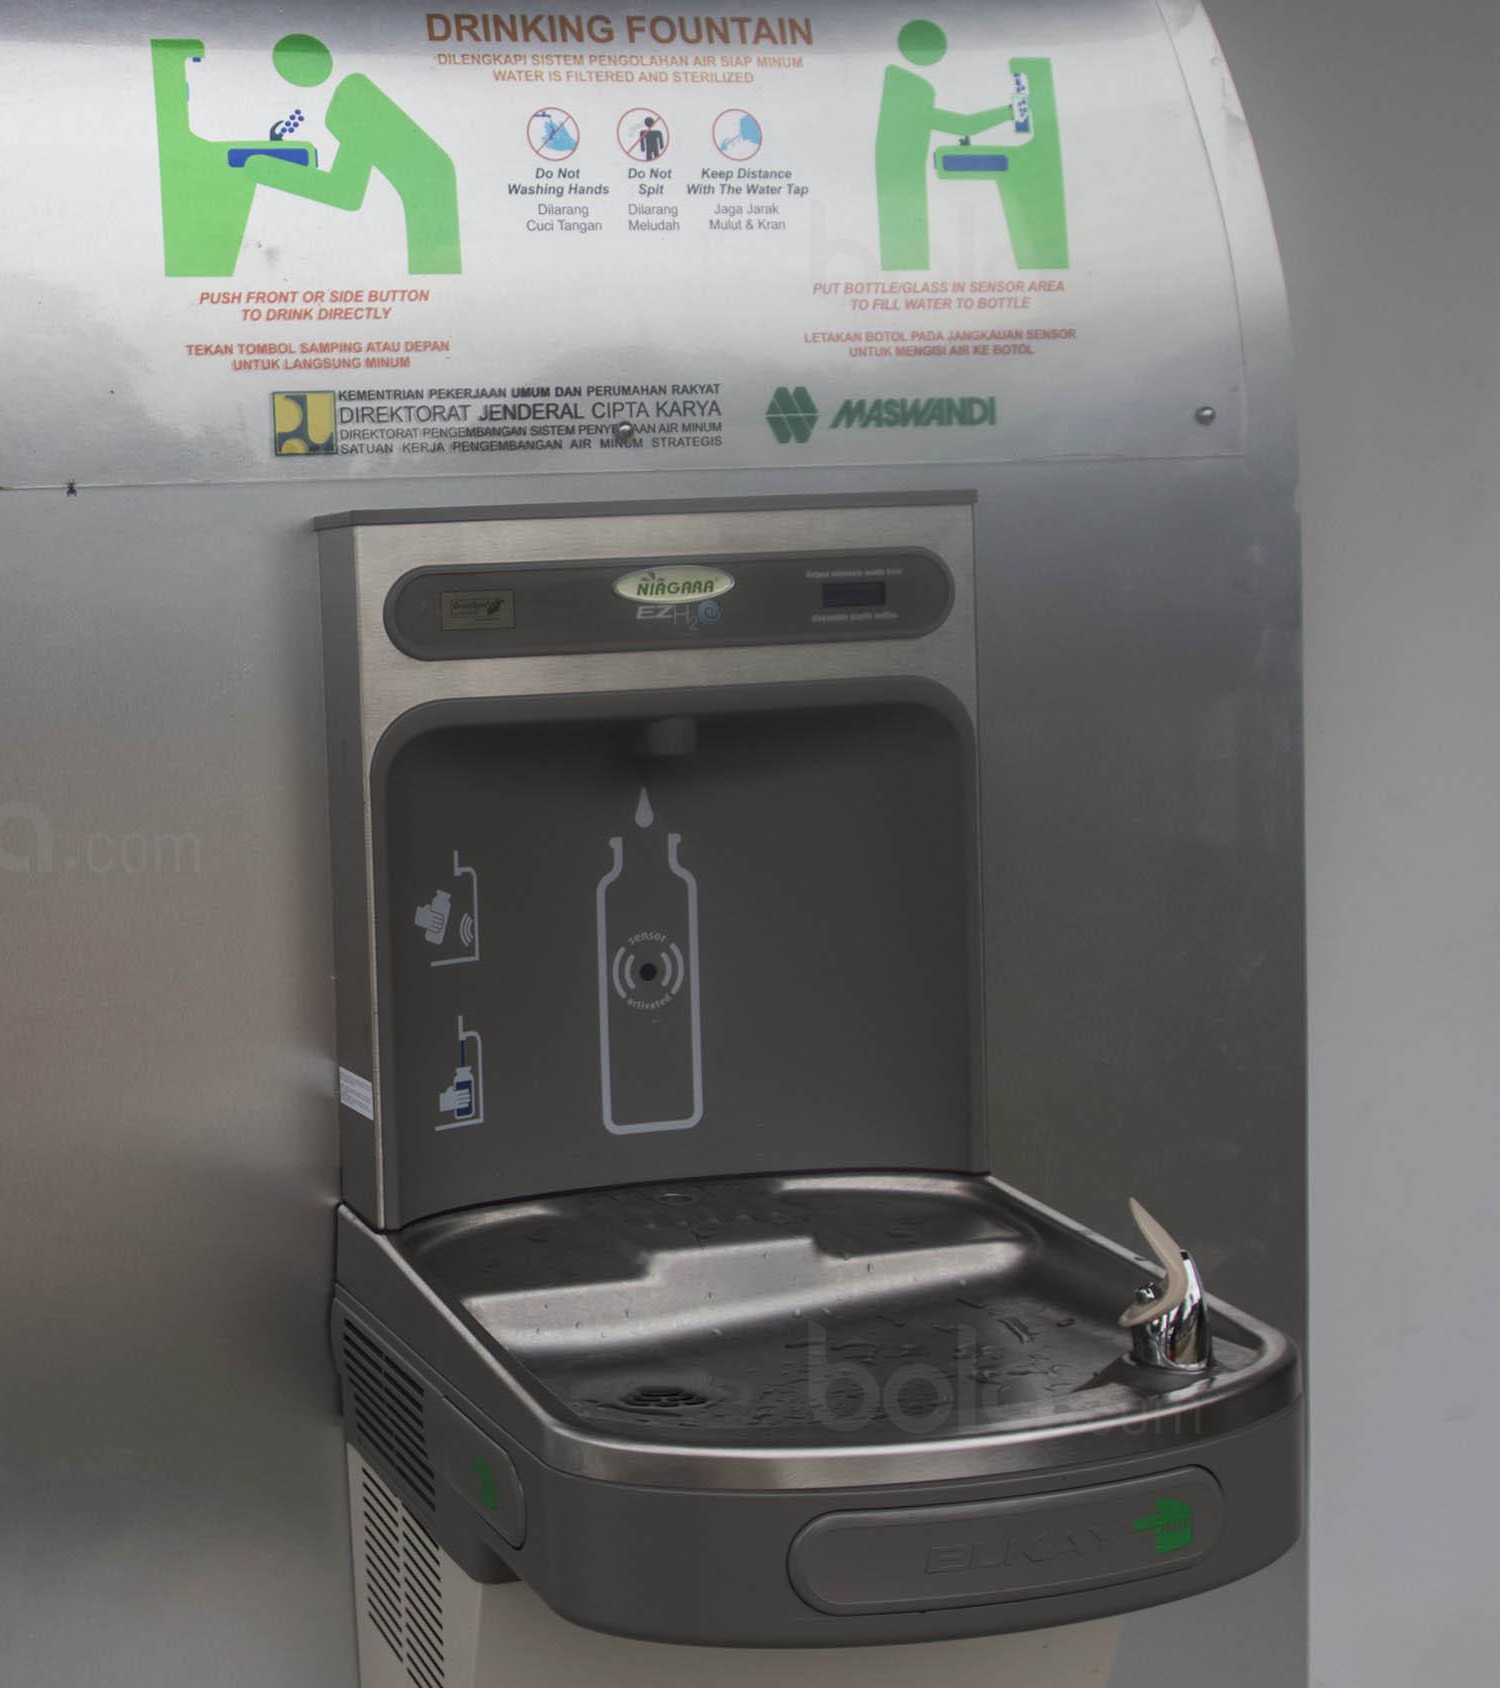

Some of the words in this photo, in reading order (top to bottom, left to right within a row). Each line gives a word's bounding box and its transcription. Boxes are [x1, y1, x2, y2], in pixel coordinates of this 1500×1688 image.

[426, 13, 614, 43] DRINKING
[627, 15, 813, 45] FOUNTAIN
[438, 53, 527, 66] DILENGKAPI
[531, 53, 584, 66] SISTEM
[590, 54, 688, 68] PENGOLAHAN
[693, 55, 716, 68] AIR
[721, 56, 752, 68] SIAP
[757, 56, 802, 68] MINUM
[493, 69, 544, 82] WATER
[548, 69, 561, 82] IS
[566, 70, 634, 83] FILTERED
[639, 71, 668, 83] AND
[673, 71, 754, 84] STERILIZED
[535, 168, 554, 180] Do
[557, 168, 581, 180] Not
[628, 168, 647, 180] Do
[650, 168, 672, 180] Not
[701, 168, 734, 182] Keep
[737, 168, 792, 180] Distance
[508, 183, 564, 198] Washing
[568, 183, 610, 196] Hands
[638, 183, 664, 198] Spit
[687, 183, 716, 196] With
[719, 183, 744, 196] The
[747, 184, 783, 196] Water
[786, 184, 809, 198] Tap
[538, 203, 589, 219] Dilarang
[628, 203, 679, 219] Dilarang
[714, 204, 744, 218] Jaga
[747, 203, 779, 216] Jarak
[527, 219, 556, 232] Cuci
[560, 219, 603, 235] Tangan
[629, 219, 680, 232] Meludah
[709, 218, 743, 231] Mulut
[746, 219, 755, 231] &
[758, 219, 786, 231] Kran
[813, 282, 840, 295] PUT
[843, 281, 948, 295] BOTTLE/GLASS
[952, 282, 965, 294] IN
[969, 281, 1023, 294] SENSOR
[1027, 280, 1065, 292] AREA
[199, 292, 241, 305] PUSH
[246, 291, 299, 304] FRONT
[302, 291, 324, 303] OR
[329, 290, 363, 303] SIDE
[368, 289, 429, 302] BUTTON
[851, 299, 869, 311] TO
[872, 298, 901, 311] FILL
[905, 298, 952, 310] WATER
[956, 297, 974, 309] TO
[978, 297, 1031, 309] BOTTLE
[242, 309, 262, 321] TO
[266, 308, 314, 321] DRINK
[318, 307, 392, 320] DIRECTLY
[804, 331, 862, 344] LETAKAN
[865, 331, 908, 343] BOTOL
[911, 330, 945, 342] PADA
[948, 329, 1024, 341] JANGKAUAN
[1026, 328, 1076, 340] SENSOR
[186, 344, 233, 356] TEKAN
[237, 343, 295, 355] TOMBOL
[300, 342, 362, 354] SAMPING
[366, 341, 400, 353] ATAU
[405, 340, 450, 352] DEPAN
[849, 346, 891, 358] UNTUK
[895, 345, 947, 357] MENGISI
[950, 345, 969, 356] AIR
[972, 344, 990, 356] KE
[993, 344, 1035, 355] BOTOL
[233, 359, 280, 371] UNTUK
[284, 358, 362, 370] LANGSUNG
[365, 357, 410, 368] MINUM
[338, 388, 424, 401] KEMENTRIAN
[429, 386, 507, 400] PEKERJAAN
[511, 386, 551, 399] UMUM
[555, 385, 582, 398] DAN
[587, 384, 668, 398] PERUMAHAN
[671, 384, 720, 396] RAKYAT
[339, 404, 472, 425] DIREKTORAT
[478, 403, 584, 422] JENDERAL
[592, 401, 651, 420] CIPTA
[656, 400, 721, 418] KARYA
[829, 396, 997, 429] MASWANDI
[340, 427, 421, 441] DIREKTORAT
[423, 425, 527, 440] PENGEMBANGAN
[531, 424, 576, 437] SISTEM
[658, 422, 678, 434] AIR
[682, 421, 723, 434] MINUM
[340, 442, 395, 456] SATUAN
[402, 441, 445, 454] KERJA
[452, 439, 564, 453] PENGEMBANGAN
[570, 439, 592, 451] AIR
[600, 437, 643, 450] MINUM
[651, 435, 723, 449] STRATEGIS
[628, 930, 668, 945] sensor
[626, 992, 672, 1011] activated
[923, 1524, 1123, 1575] ELKAY
